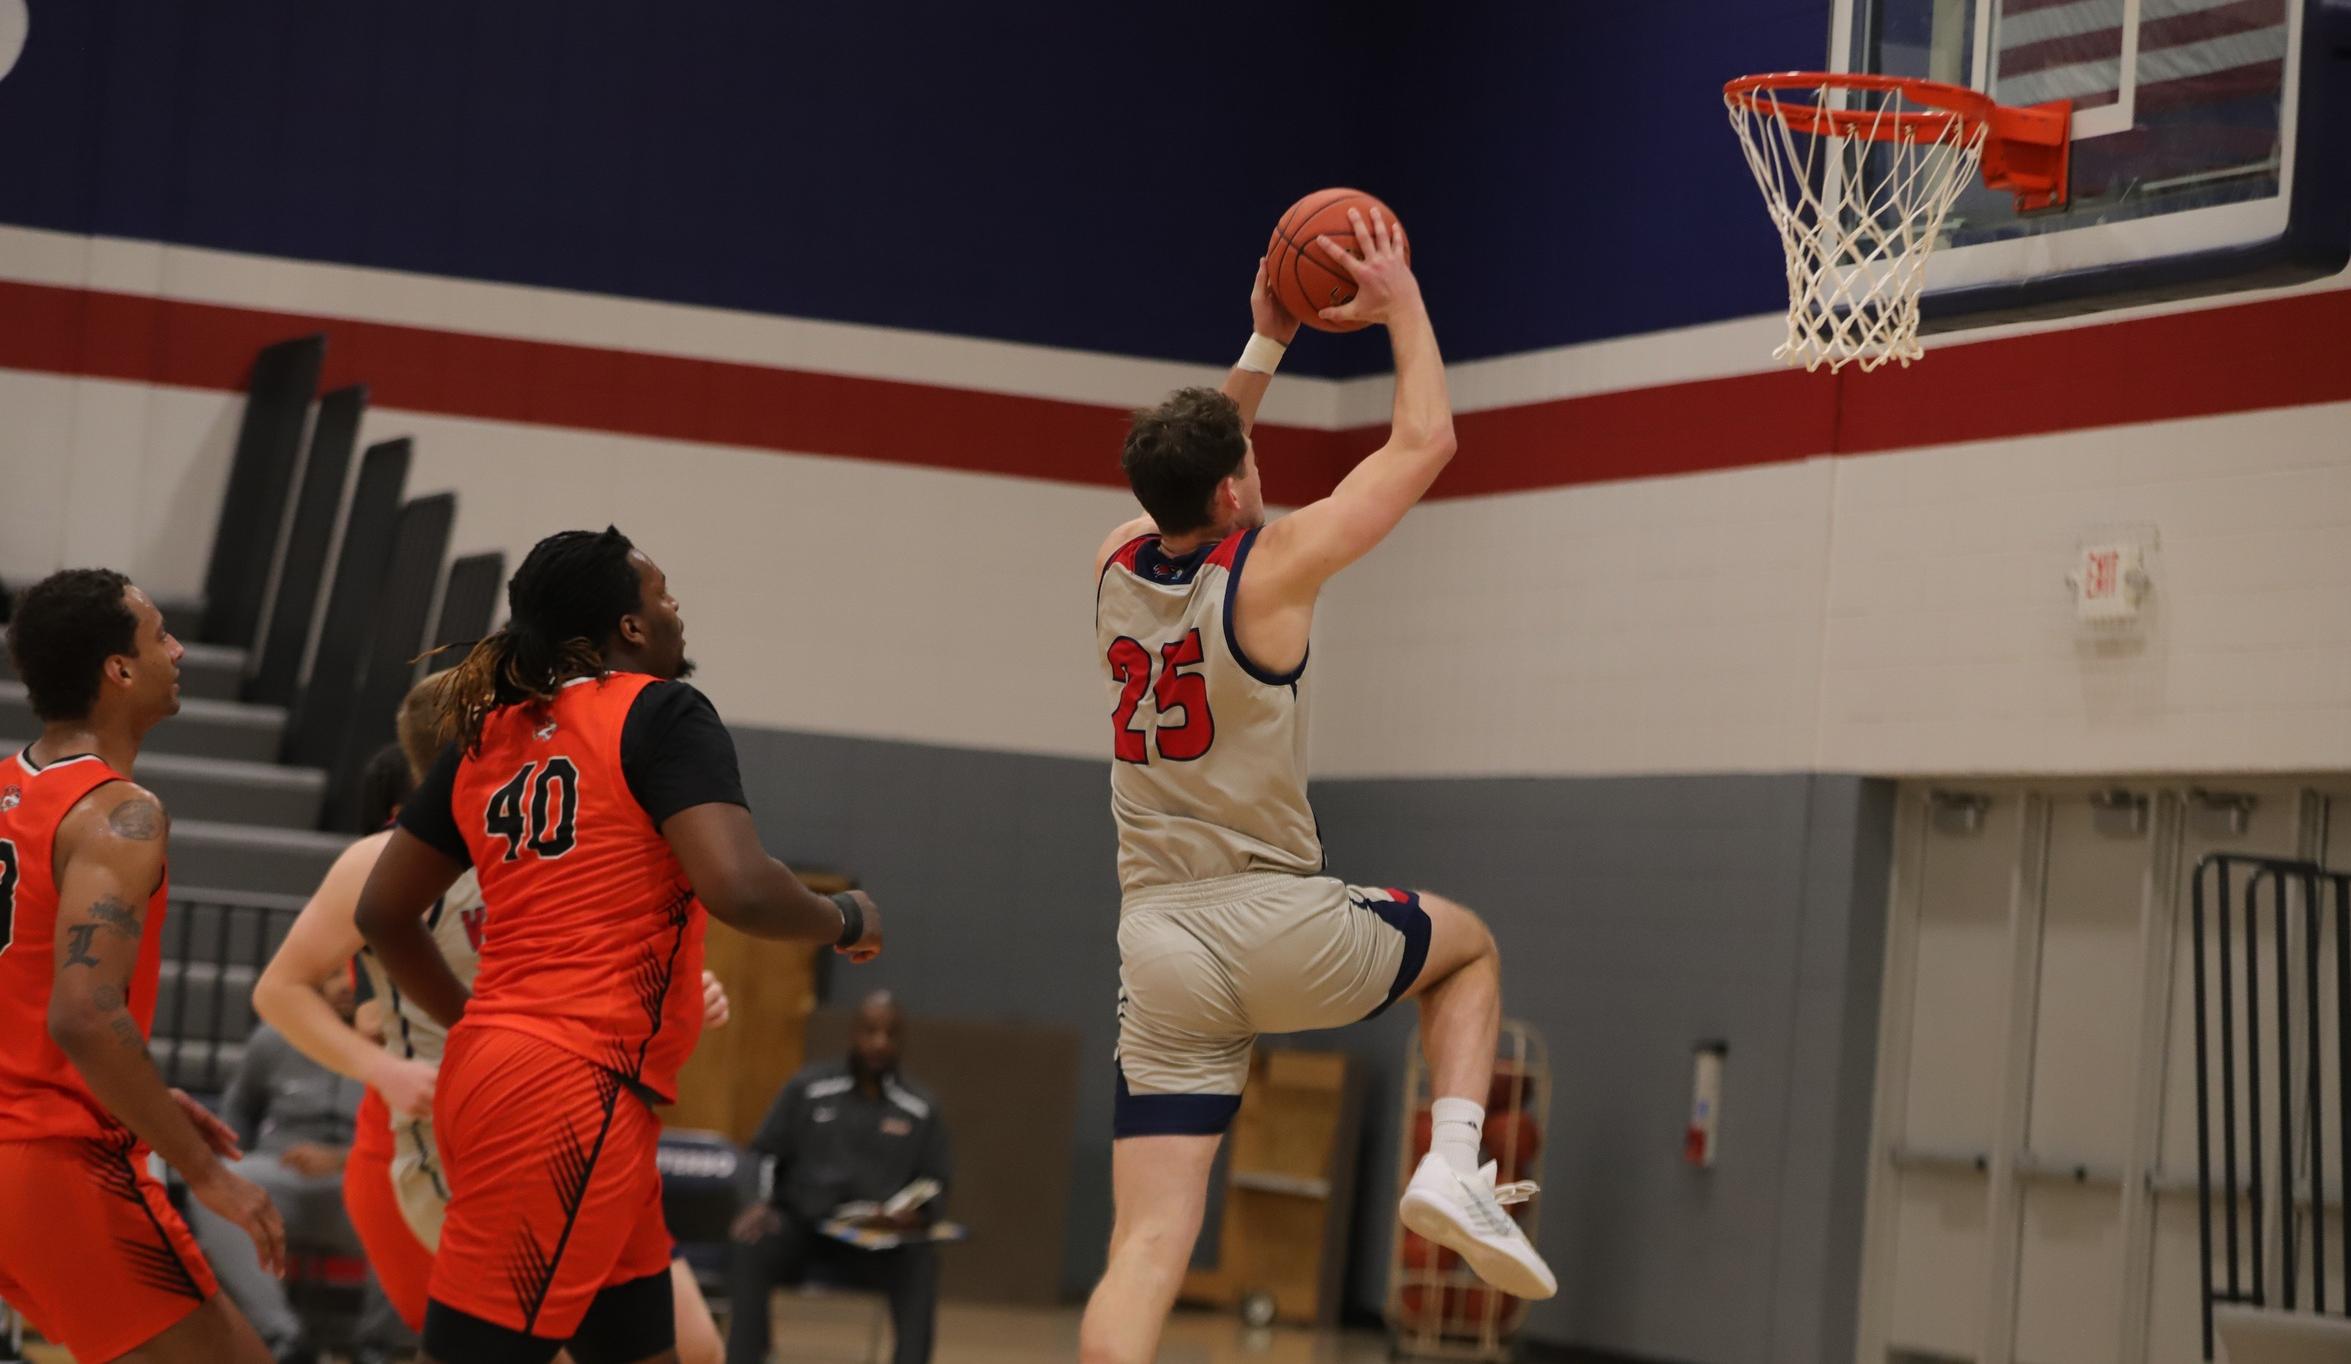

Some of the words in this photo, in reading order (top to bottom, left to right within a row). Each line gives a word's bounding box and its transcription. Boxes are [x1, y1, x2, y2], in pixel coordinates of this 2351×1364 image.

[2084, 549, 2119, 600] EXIT
[1107, 627, 1215, 765] 25
[484, 755, 579, 863] 40
